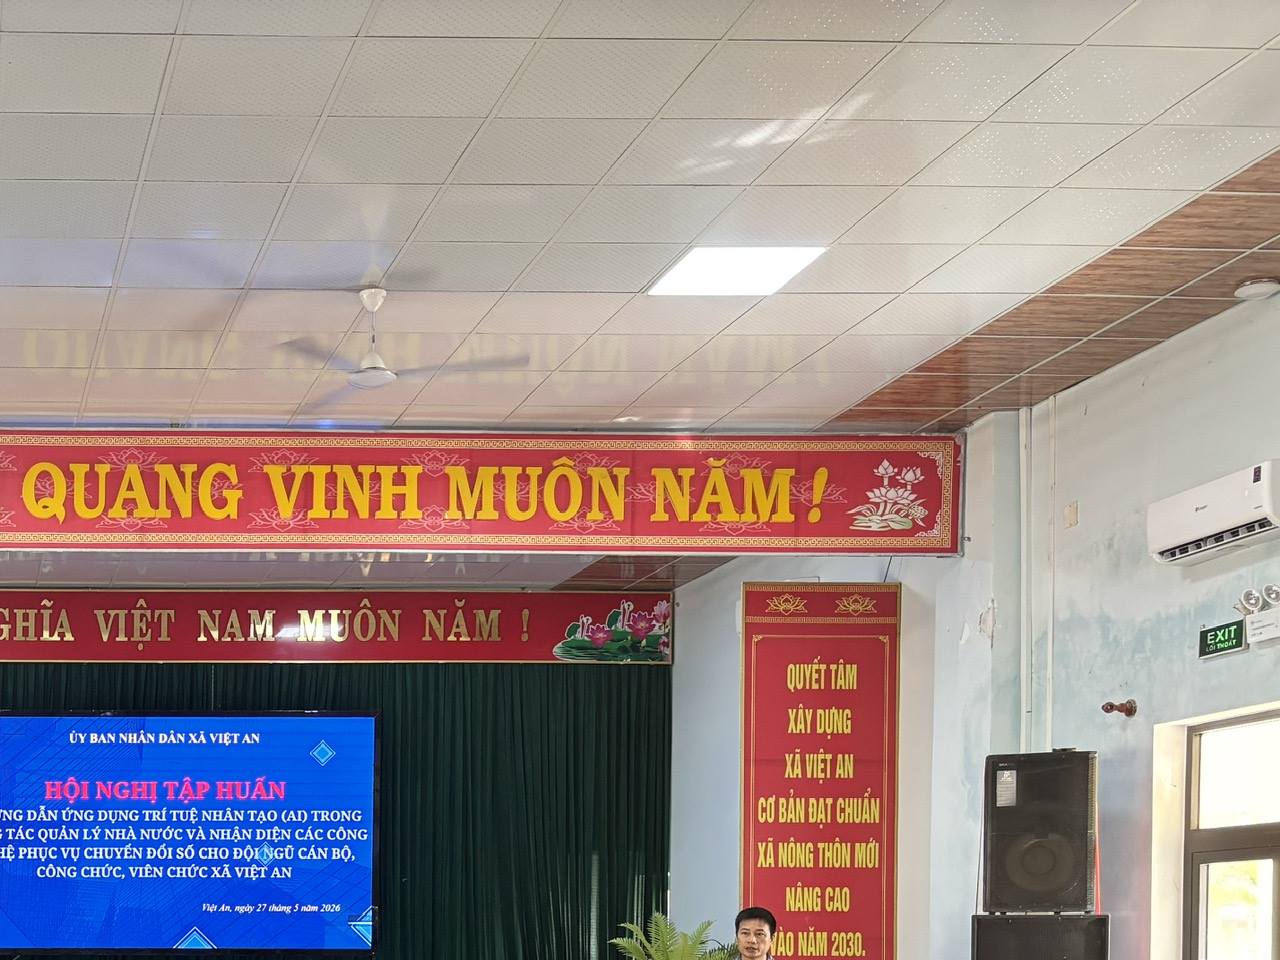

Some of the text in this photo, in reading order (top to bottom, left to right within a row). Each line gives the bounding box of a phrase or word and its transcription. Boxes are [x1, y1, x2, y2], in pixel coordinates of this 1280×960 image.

[21, 462, 244, 523] QUANG
[264, 463, 424, 521] VINH
[444, 451, 630, 523] MUÔN
[93, 599, 175, 651] VIỆT
[197, 609, 276, 642] NAM
[296, 599, 402, 643] MUÔN
[422, 599, 502, 642] NĂM
[1207, 625, 1237, 643] EXIT
[787, 656, 858, 692] QUYẾT TÂM
[788, 703, 852, 739] XÂY DỰNG
[69, 730, 260, 746] ỦY BAN NHÂN DÂN XÃ VIỆT AN
[785, 748, 854, 784] XÃ VIỆT AN
[45, 776, 286, 804] HỘI NGHỊ TẬP HUẤN
[27, 805, 59, 822] DẪN
[62, 807, 95, 822] ỨNG
[97, 809, 140, 824] DỤNG
[142, 807, 167, 822] TRÍ
[170, 807, 199, 824] TUỆ
[201, 807, 245, 822] NHÂN
[247, 810, 278, 824] TẠO
[281, 809, 308, 823] (AI)
[311, 810, 362, 822] TRONG
[758, 787, 880, 829] CƠ BẢN ĐẠT CHUẨN
[6, 825, 35, 840] TÁC
[38, 825, 80, 843] QUẢN
[83, 825, 102, 840] LÝ
[105, 825, 137, 840] NHÀ
[140, 825, 183, 841] NƯỚC
[186, 826, 207, 840] VÀ
[209, 826, 253, 843] NHẬN
[255, 826, 292, 843] DIỆN
[295, 826, 324, 841] CÁC
[327, 826, 369, 841] CÔNG
[18, 846, 58, 862] PHỤC
[60, 847, 81, 862] VỤ
[84, 843, 143, 860] CHUYỂN
[176, 844, 195, 860] SỐ
[198, 847, 230, 860] CHO
[232, 844, 260, 862] ĐỘI
[262, 844, 295, 860] NGŨ
[297, 844, 329, 860] CÁN
[331, 845, 356, 863] BỘ,
[757, 837, 879, 868] XÃ NÔNG THÔN MỚI
[36, 863, 292, 881] CÔNG CHỨC, VIÊN CHỨC XÃ VIỆT AN
[202, 903, 218, 913] Việt
[219, 904, 233, 914] An,
[234, 904, 255, 914] ngày
[256, 903, 268, 912] 27
[269, 903, 292, 914] tháng
[320, 903, 341, 913] 2026
[786, 882, 850, 912] NÂNG CAO
[798, 927, 828, 957] NĂM
[831, 932, 866, 957] 2030.
